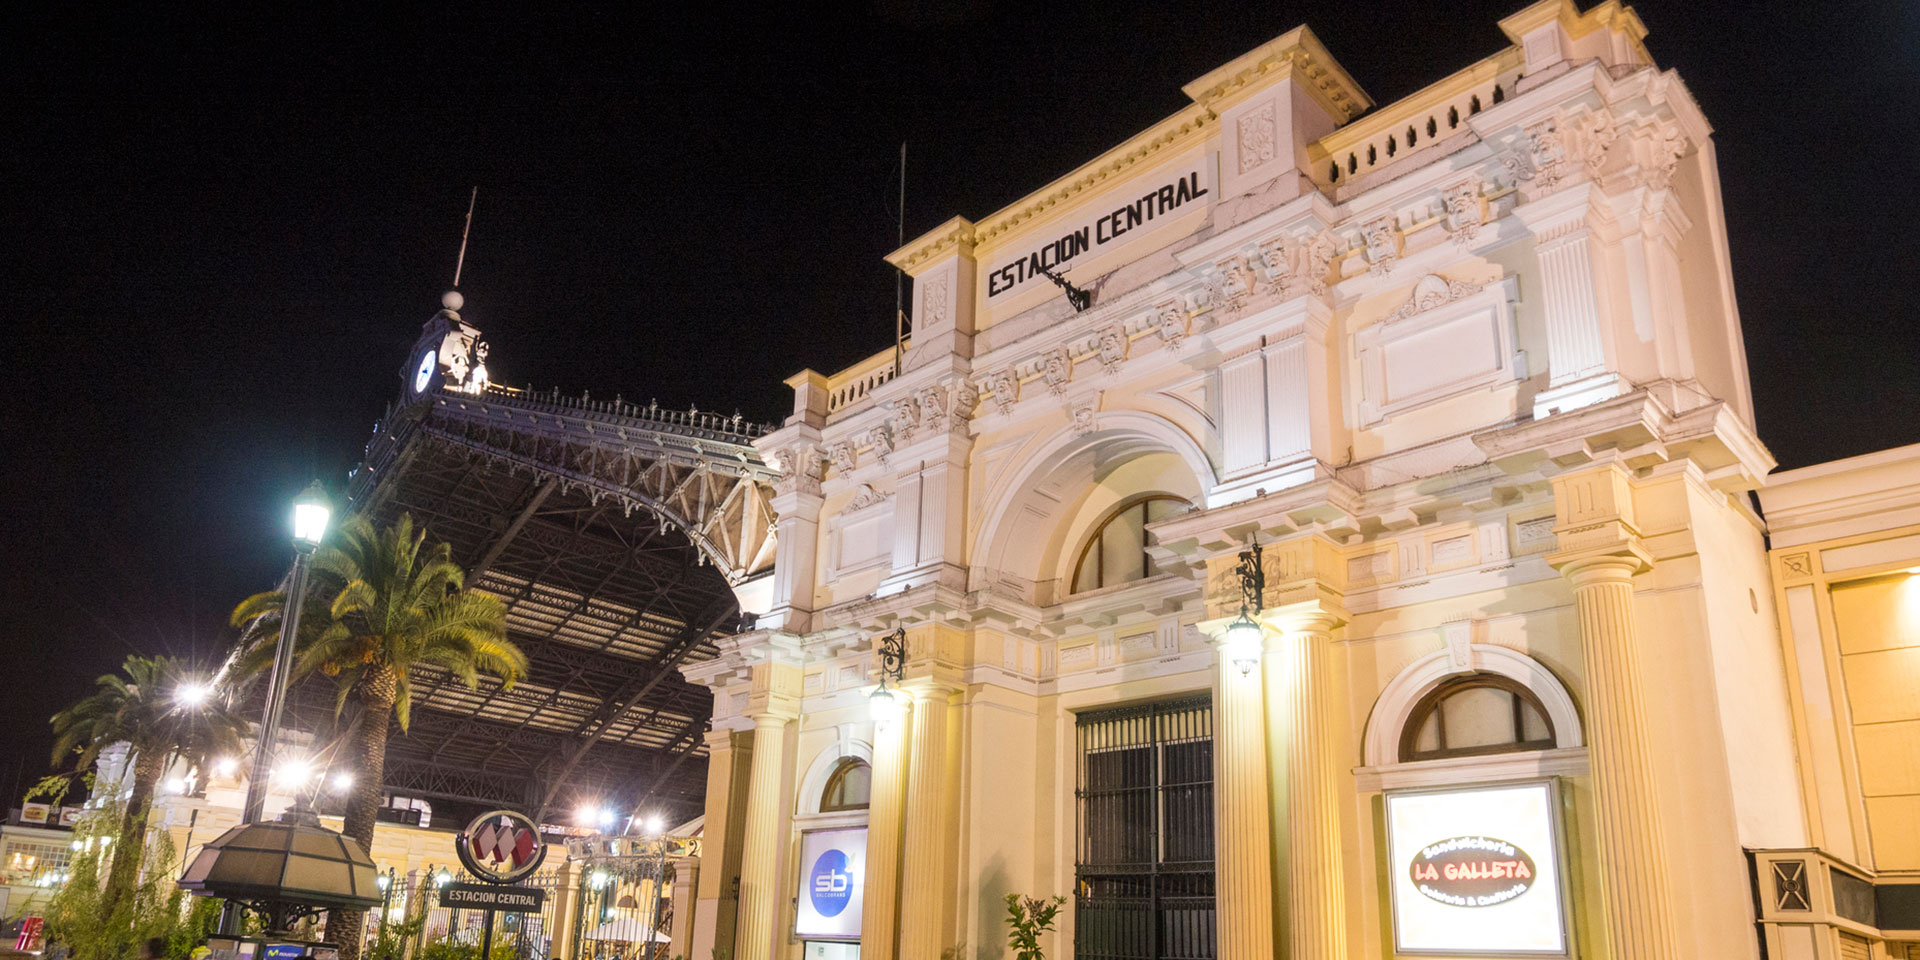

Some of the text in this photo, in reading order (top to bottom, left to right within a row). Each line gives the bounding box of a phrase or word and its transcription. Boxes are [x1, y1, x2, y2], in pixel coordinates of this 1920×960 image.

[989, 171, 1208, 298] ESTACION CENTRAL
[815, 869, 848, 892] sb
[1414, 860, 1532, 881] LA GALLETA
[449, 890, 536, 906] ESTACION CENTRAL
